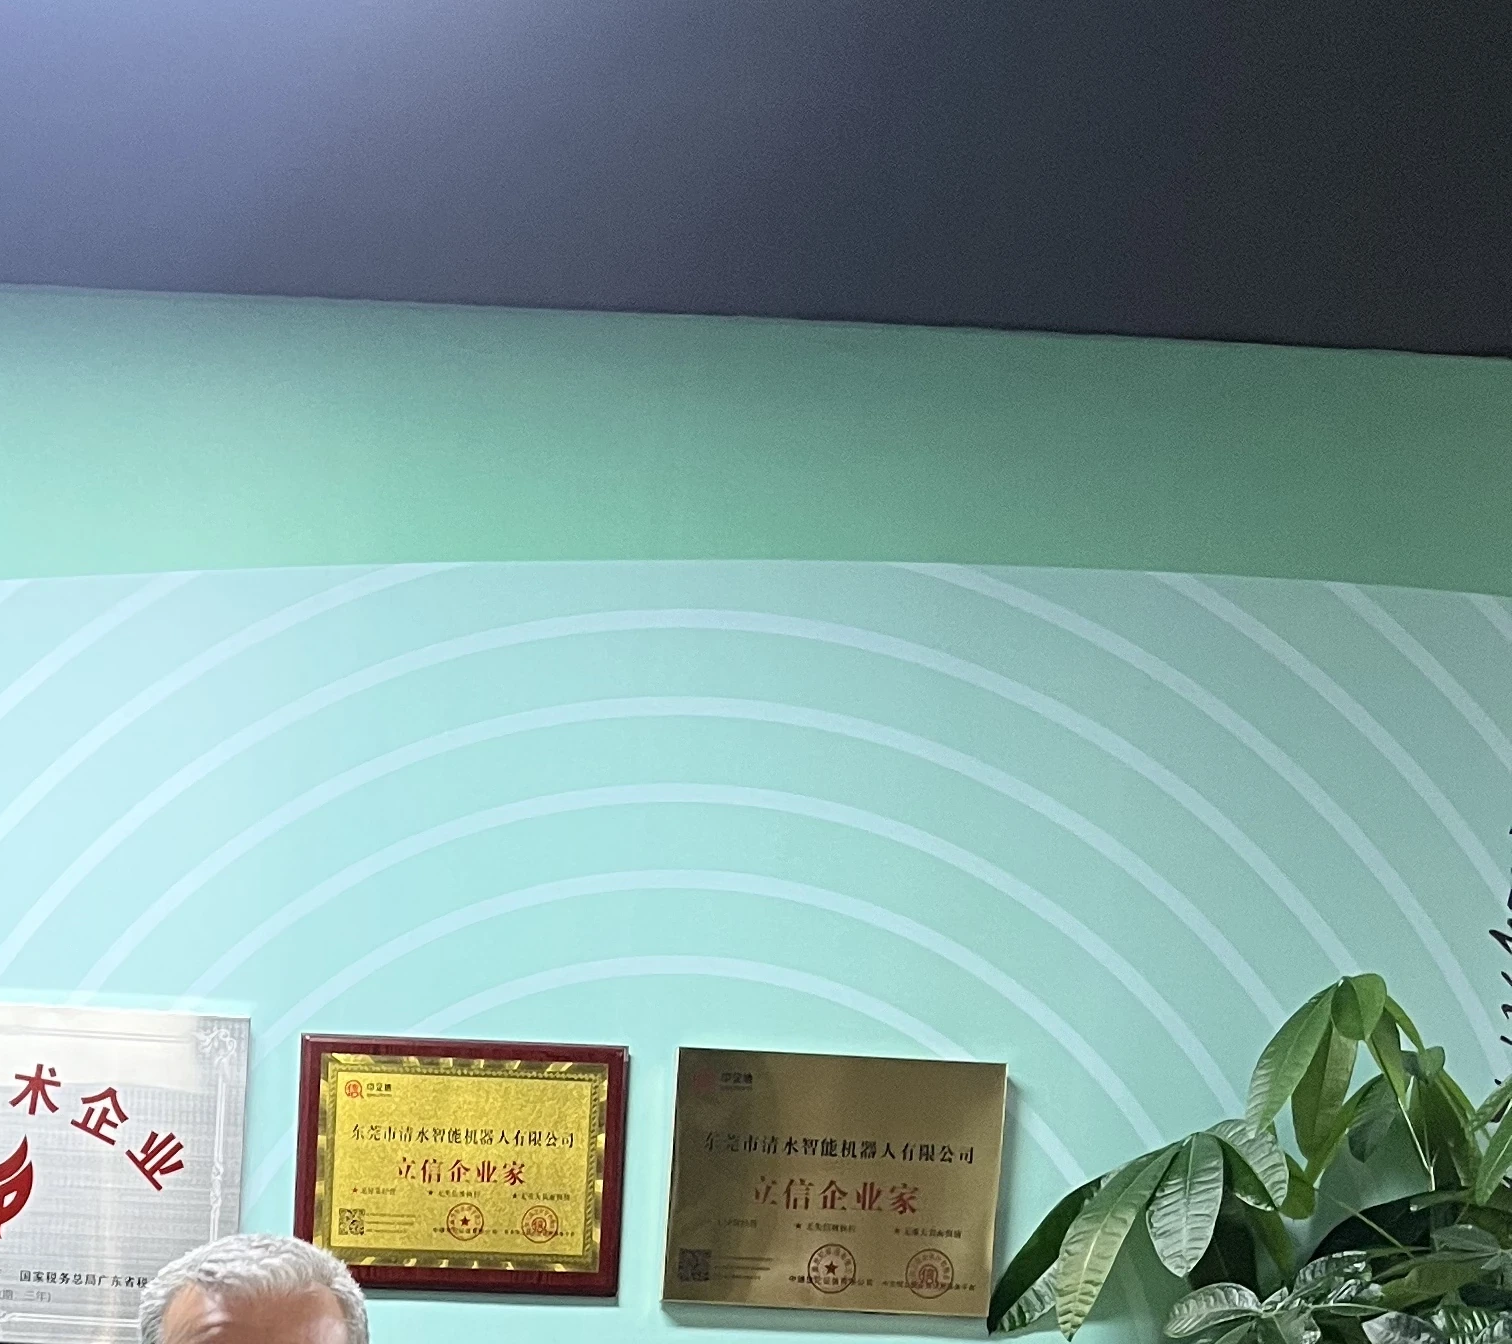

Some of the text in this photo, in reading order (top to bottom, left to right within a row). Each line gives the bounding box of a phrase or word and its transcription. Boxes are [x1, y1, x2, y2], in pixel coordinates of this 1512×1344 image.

[351, 1123, 574, 1148] 东莞市清水智能机器人有限公司
[704, 1131, 975, 1165] 东莞市清水智能机器人有限公司
[397, 1156, 526, 1186] 立信企业家
[754, 1175, 919, 1215] 立信企业家
